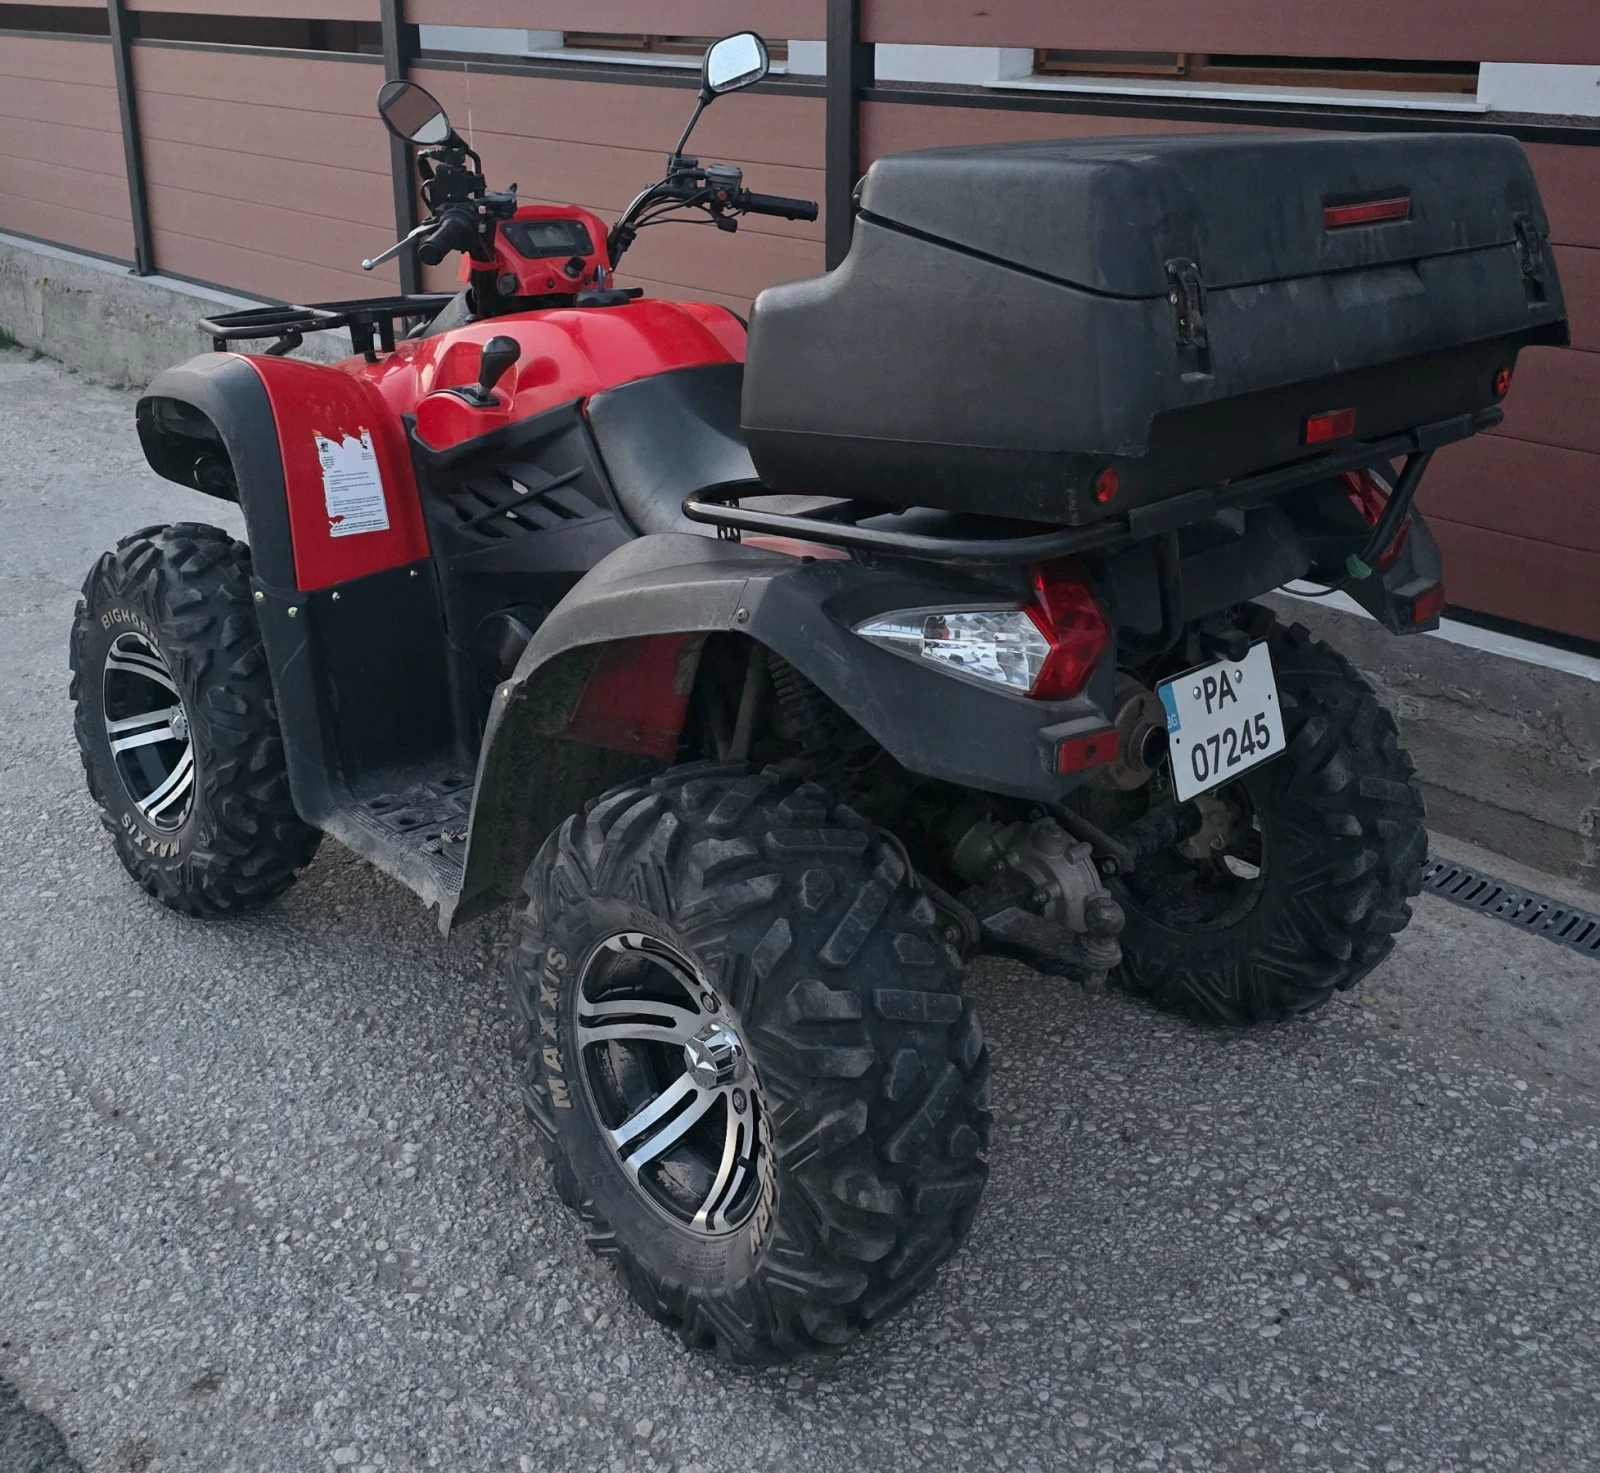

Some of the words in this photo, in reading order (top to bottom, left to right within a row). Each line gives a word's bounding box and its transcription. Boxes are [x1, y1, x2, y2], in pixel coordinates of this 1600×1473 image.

[101, 608, 159, 647] BIGHORN
[1202, 670, 1237, 714] PA
[1191, 712, 1270, 782] 07245
[121, 812, 180, 858] MAXXIS
[539, 946, 572, 1108] MAXXIS
